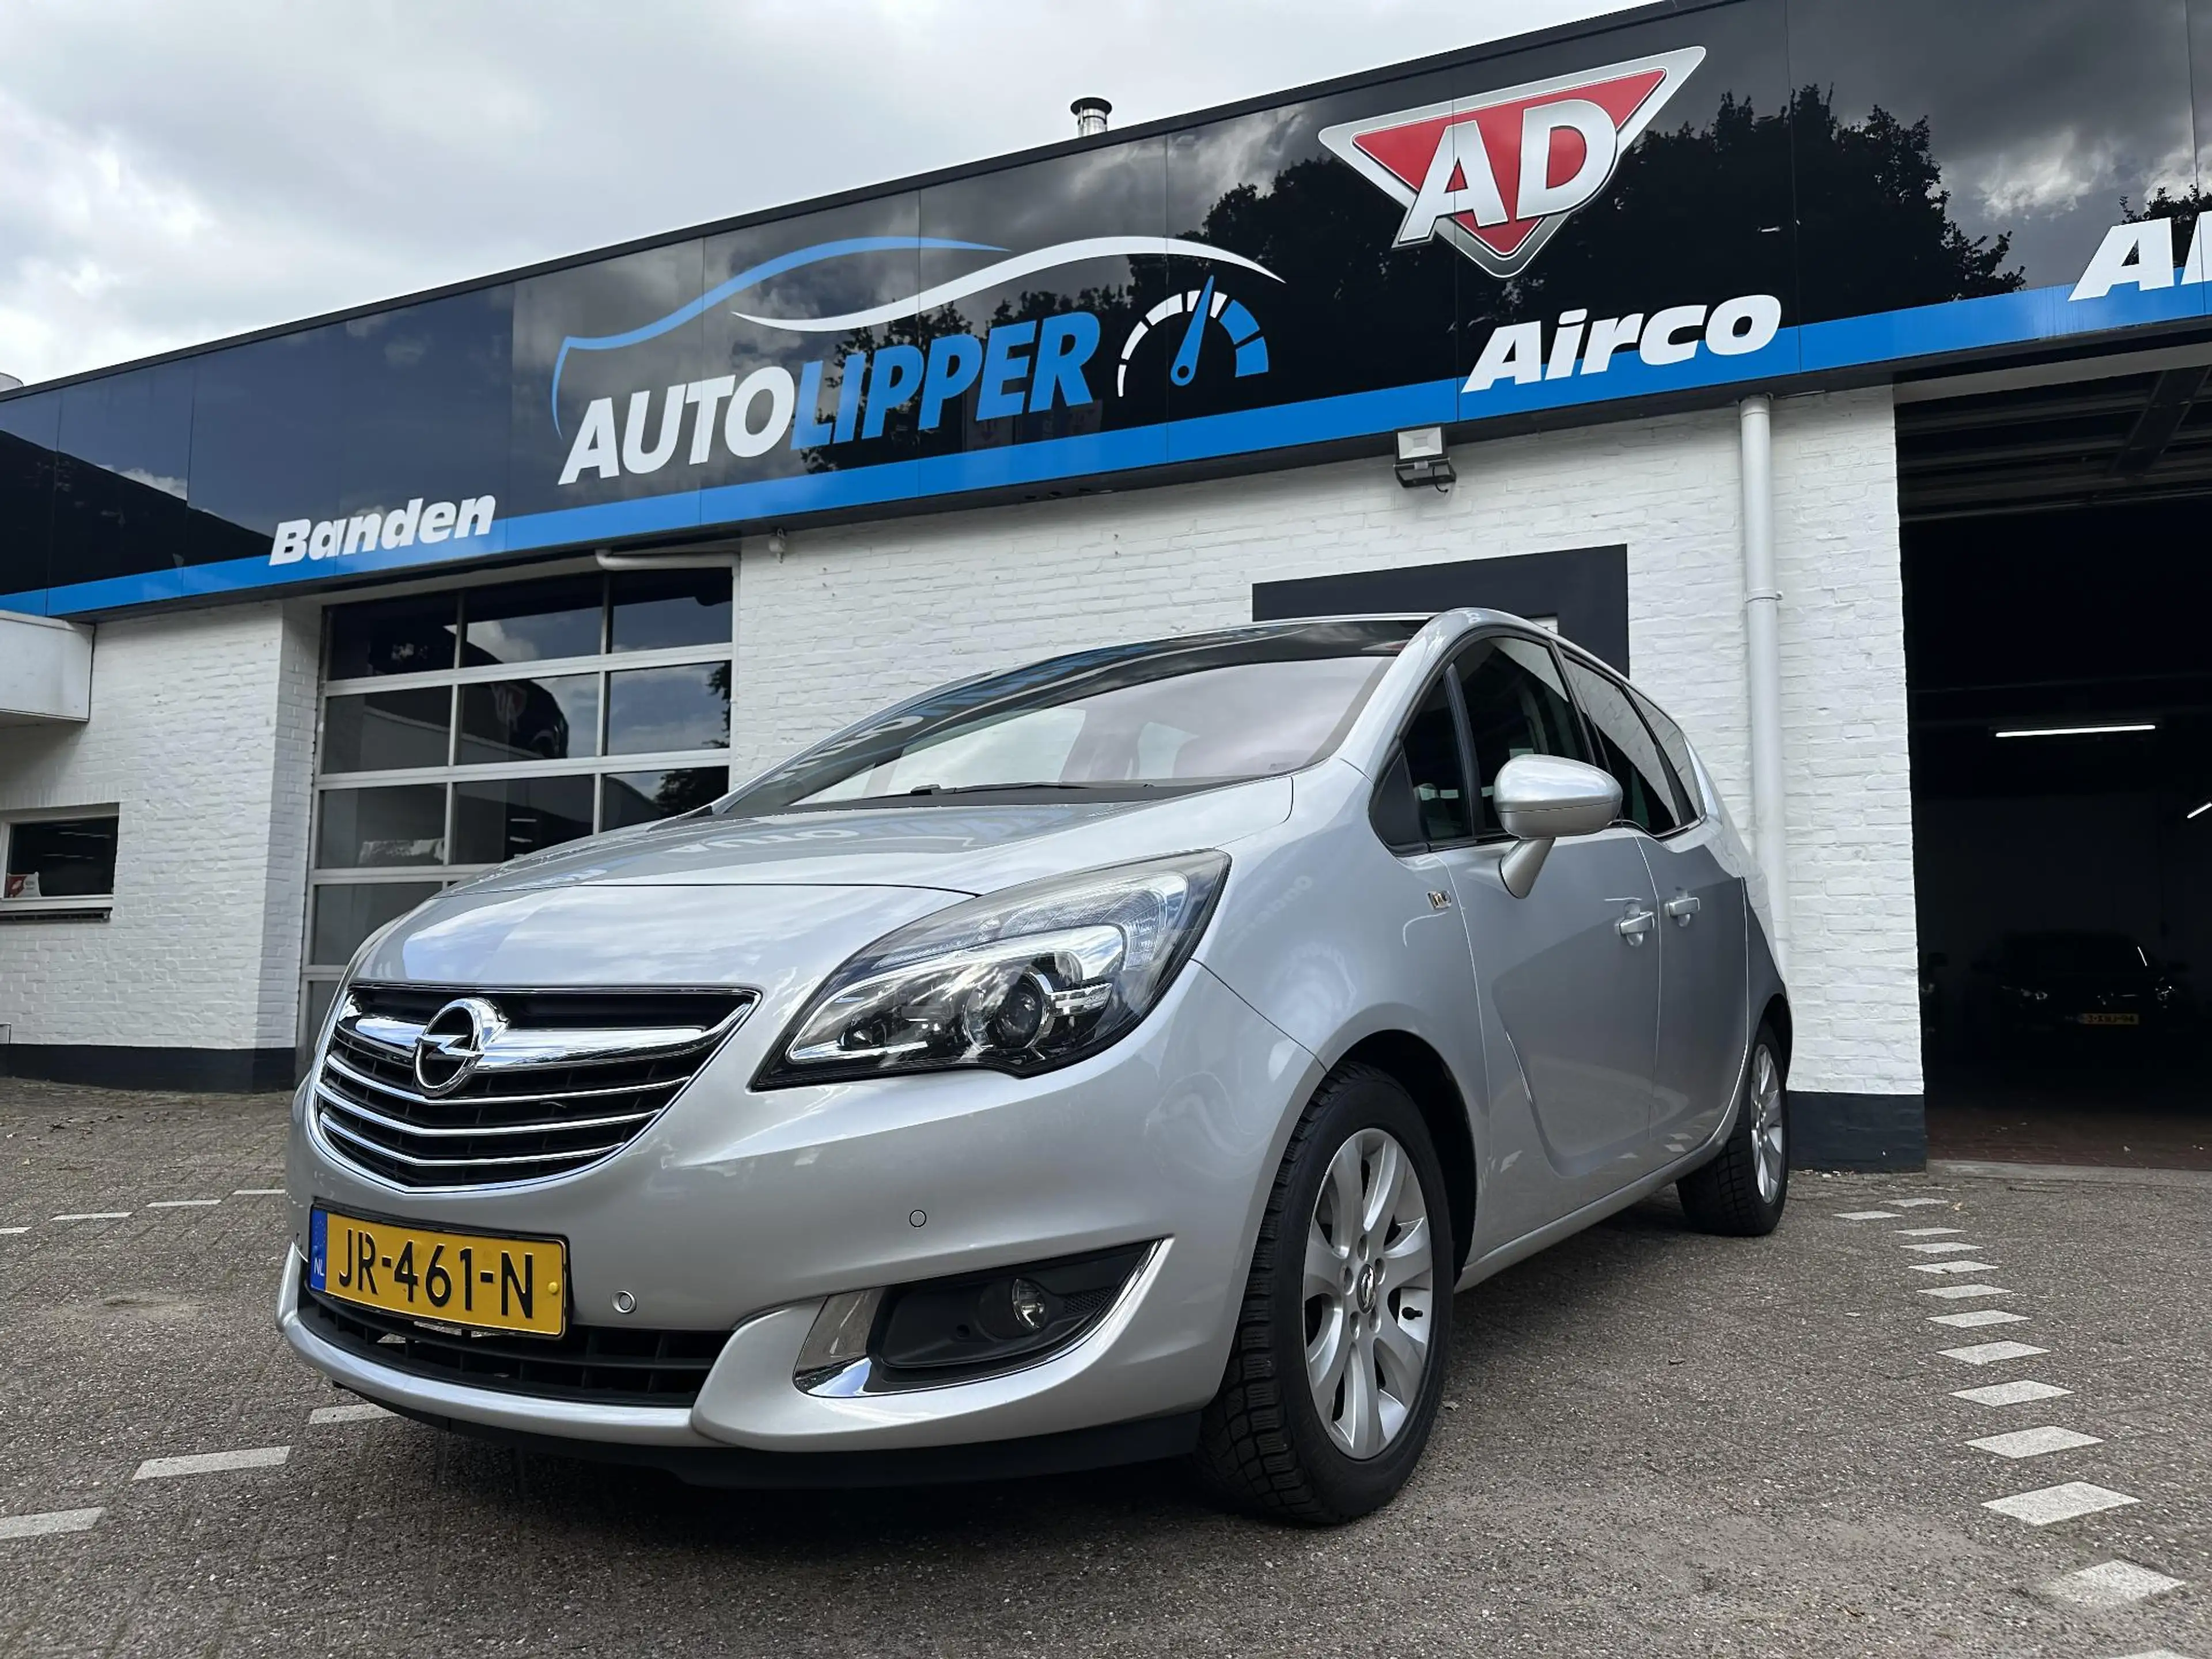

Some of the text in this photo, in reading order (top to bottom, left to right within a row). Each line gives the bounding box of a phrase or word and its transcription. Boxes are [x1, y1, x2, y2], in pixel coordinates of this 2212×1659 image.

[1392, 99, 1618, 248] AD
[1461, 294, 1782, 393] Airco
[558, 312, 1100, 485] AUTOLIPPER
[268, 494, 496, 566] Banden
[313, 1257, 325, 1277] NL
[338, 1228, 533, 1319] JR-461-N
